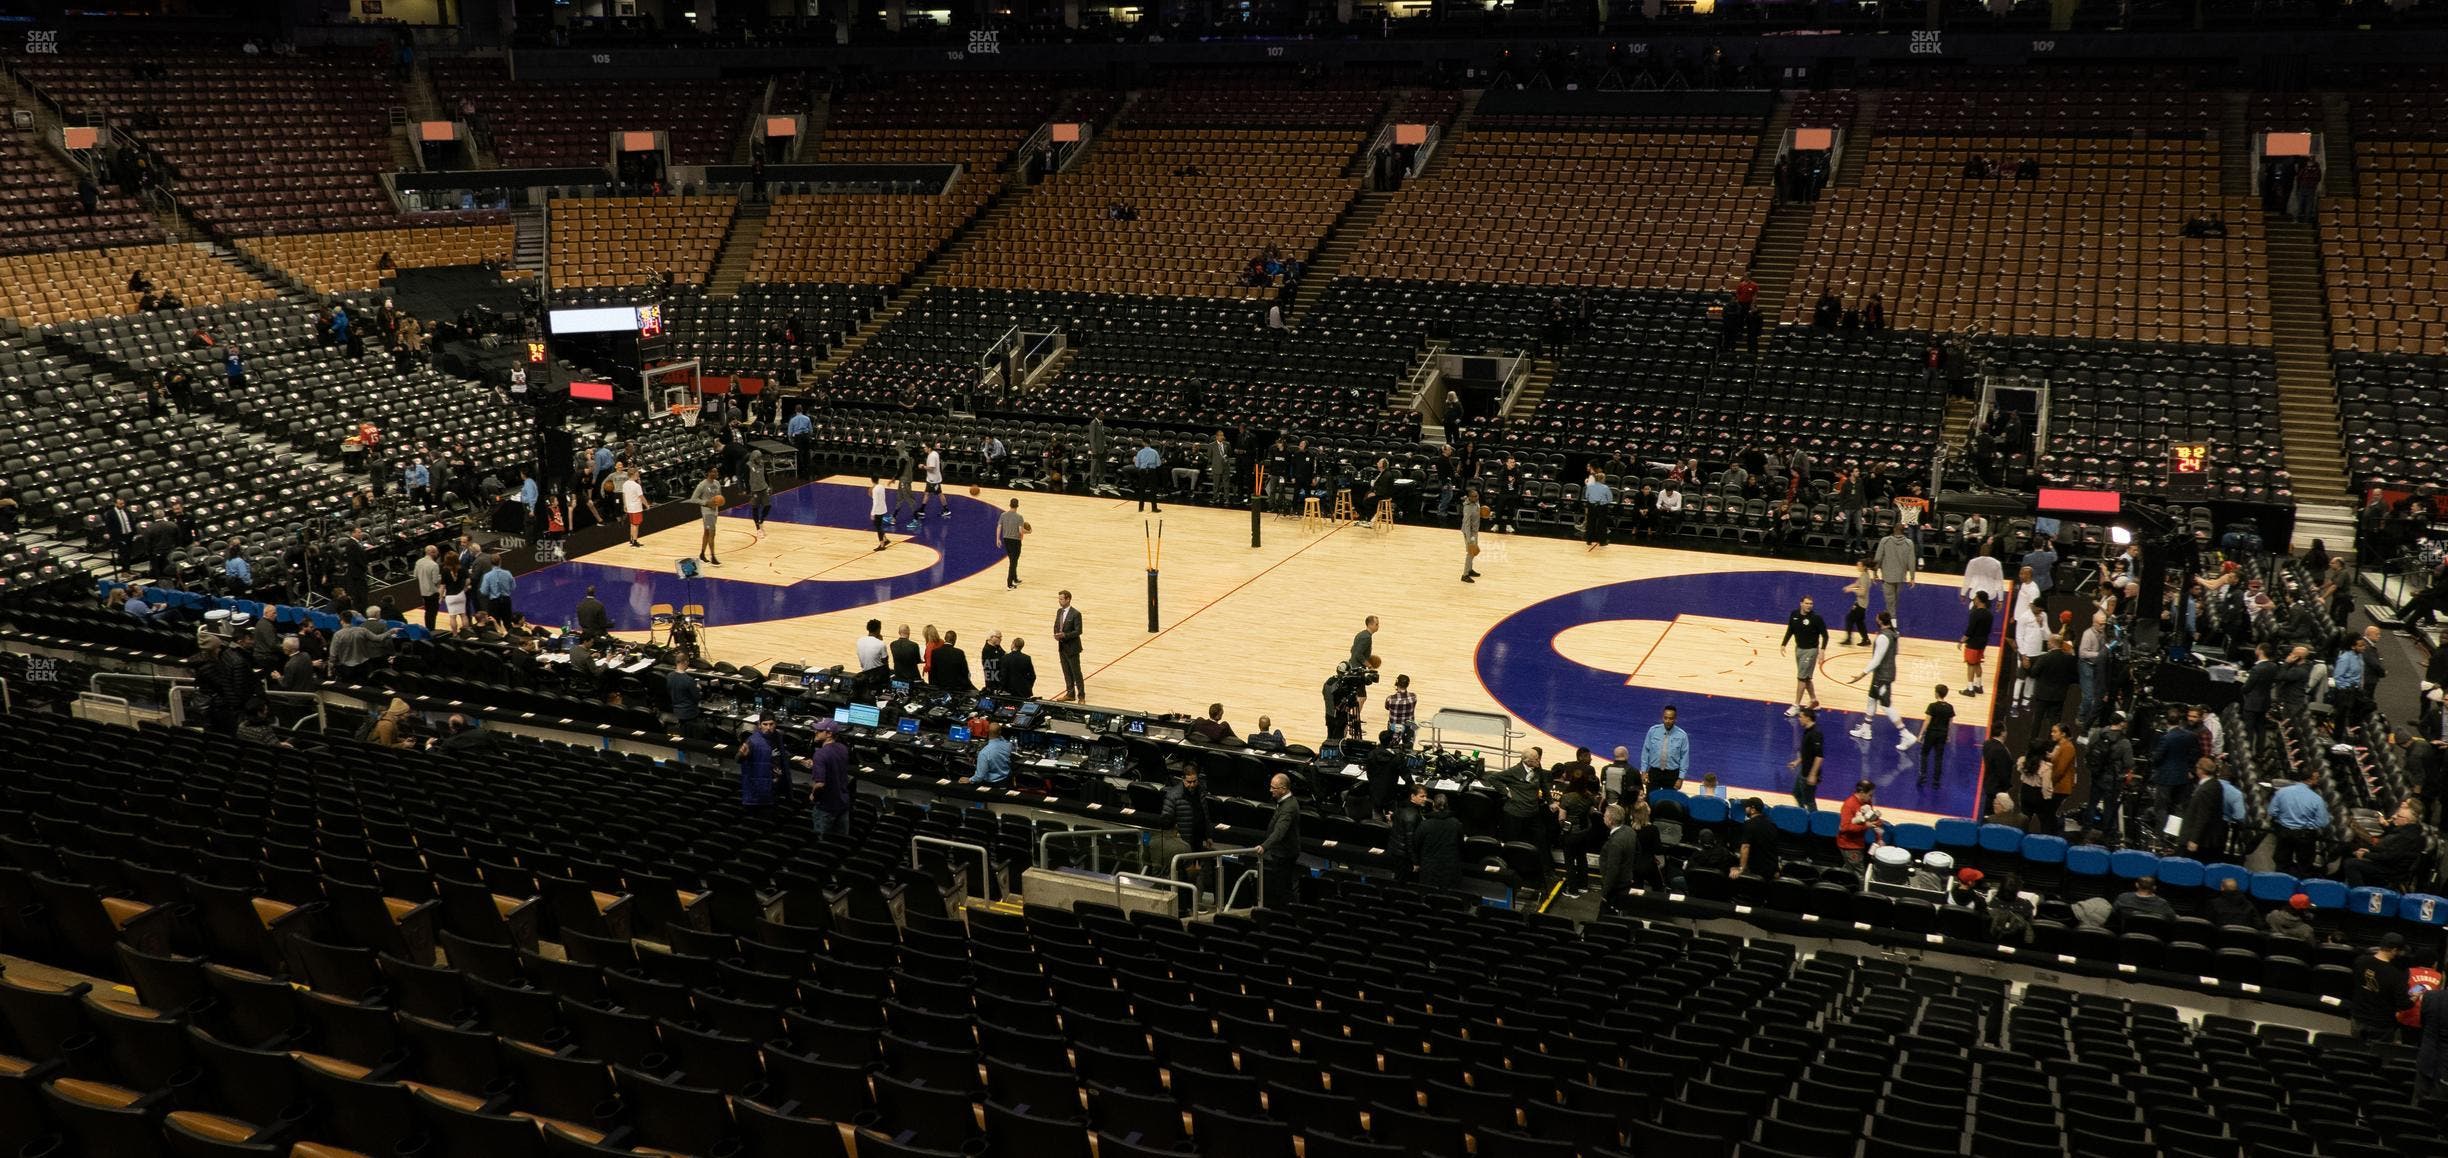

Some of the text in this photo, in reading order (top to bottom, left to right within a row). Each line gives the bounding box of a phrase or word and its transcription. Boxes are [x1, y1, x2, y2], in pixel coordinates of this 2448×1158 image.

[2032, 40, 2055, 51] 109
[947, 51, 964, 60] 106
[1267, 47, 1284, 56] 107
[592, 54, 611, 64] 105
[2178, 458, 2201, 472] 24
